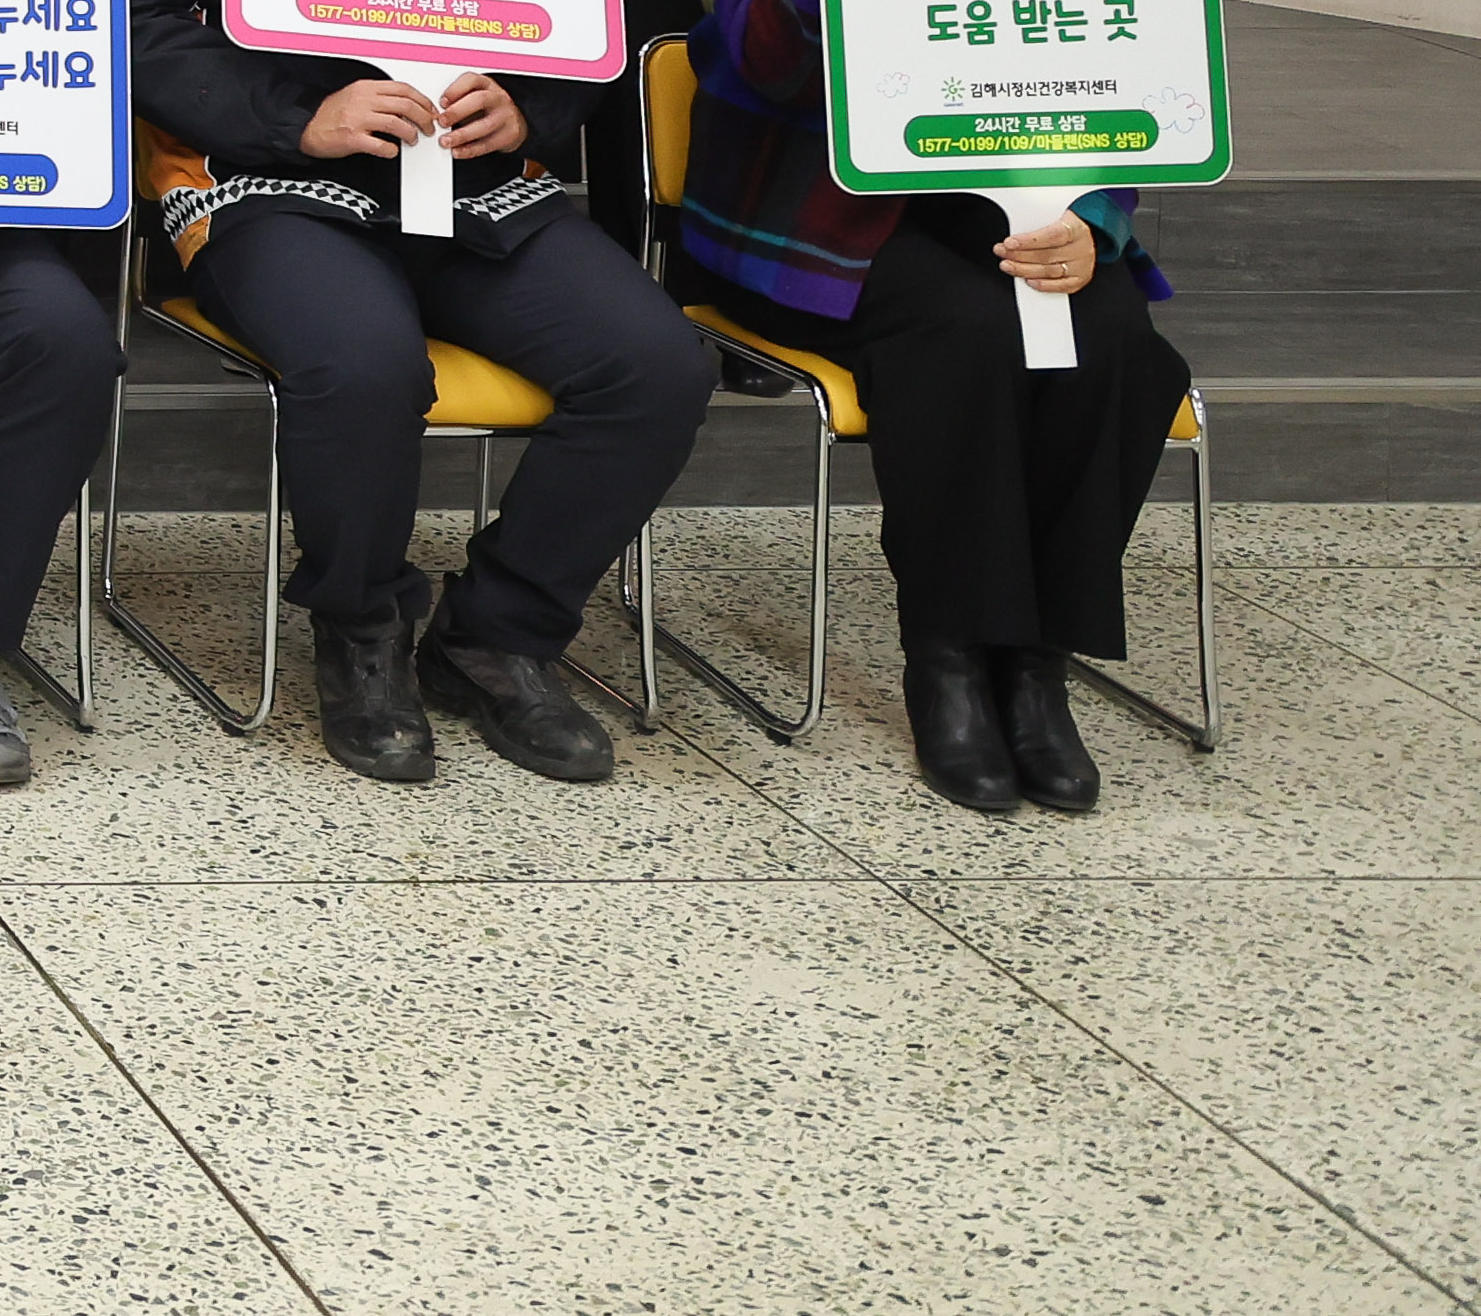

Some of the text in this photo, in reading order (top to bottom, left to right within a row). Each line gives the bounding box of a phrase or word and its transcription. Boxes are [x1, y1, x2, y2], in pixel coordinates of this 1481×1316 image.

[308, 4, 540, 40] 1577-0199/109/마들랜(SNS 상담)
[926, 0, 998, 46] 도움
[1012, 0, 1089, 44] 받는
[970, 78, 1118, 98] 김해시정신건강복지센터
[975, 115, 1087, 133] 24시간 무료 상담
[916, 132, 1147, 154] 1577-0199/109/마들랜(SNS 상담)
[12, 175, 47, 192] 상담)
